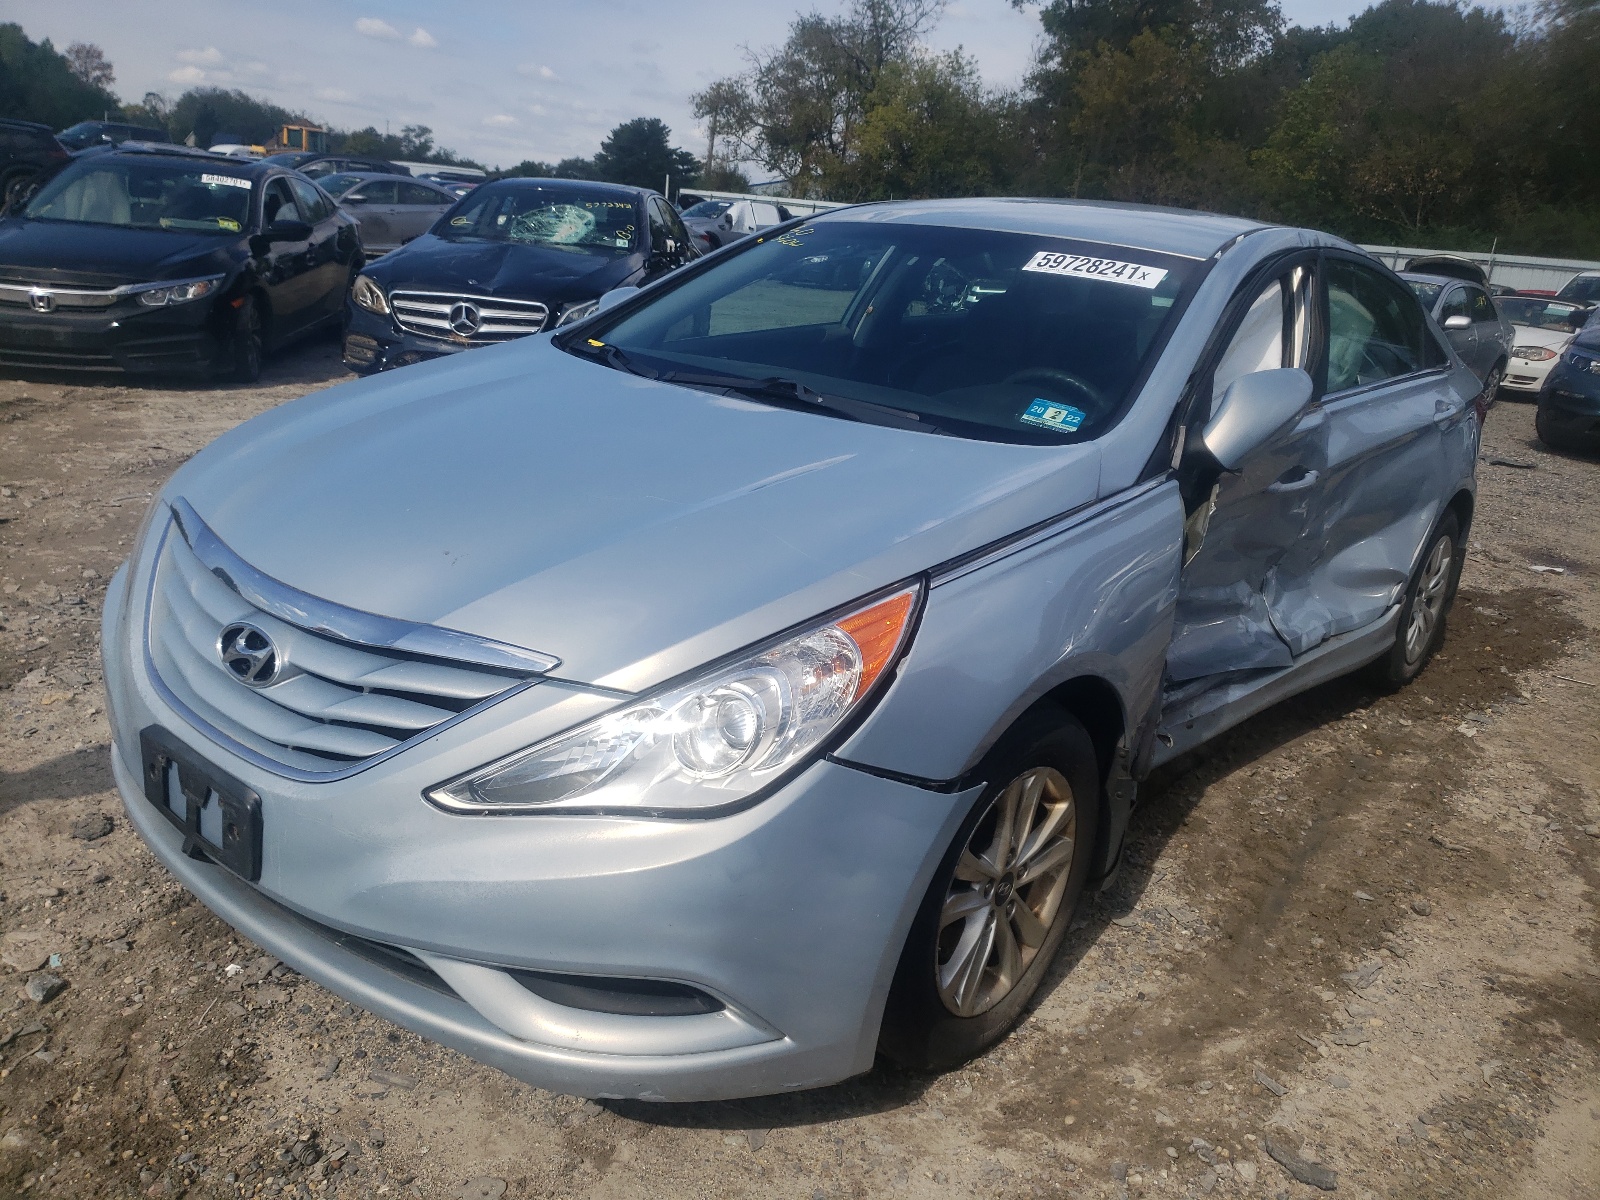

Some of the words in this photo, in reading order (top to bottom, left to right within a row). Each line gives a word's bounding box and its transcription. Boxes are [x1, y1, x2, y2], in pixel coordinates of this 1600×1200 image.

[1030, 405, 1045, 414] 20
[1049, 410, 1062, 420] 2
[1065, 414, 1081, 424] 22
